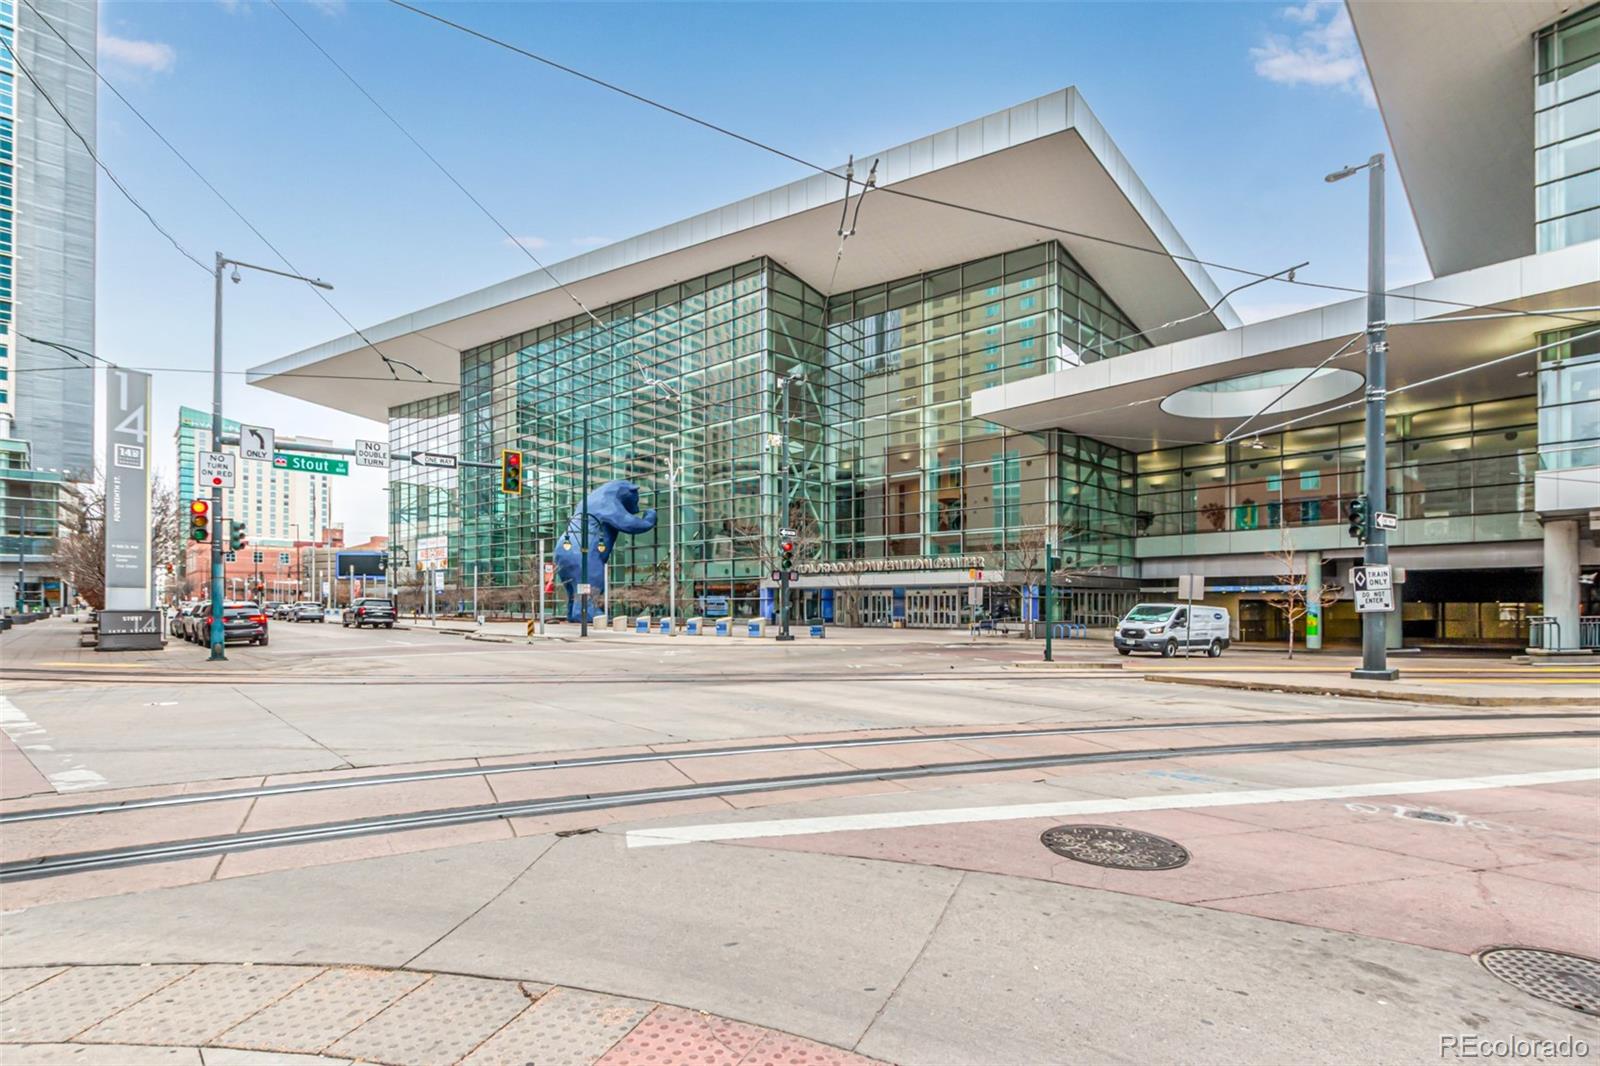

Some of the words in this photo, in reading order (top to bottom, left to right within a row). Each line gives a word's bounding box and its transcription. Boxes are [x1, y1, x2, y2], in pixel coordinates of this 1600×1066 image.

[113, 371, 147, 444] 14
[365, 443, 381, 451] NO
[209, 454, 225, 462] NO
[246, 450, 267, 458] ONLY
[359, 450, 387, 459] DOUBLE
[207, 462, 229, 470] TURN
[293, 457, 329, 471] Stout
[201, 469, 215, 477] ON
[217, 470, 233, 478] RED
[854, 557, 933, 572] CONVENTION
[934, 556, 985, 569] CENTER
